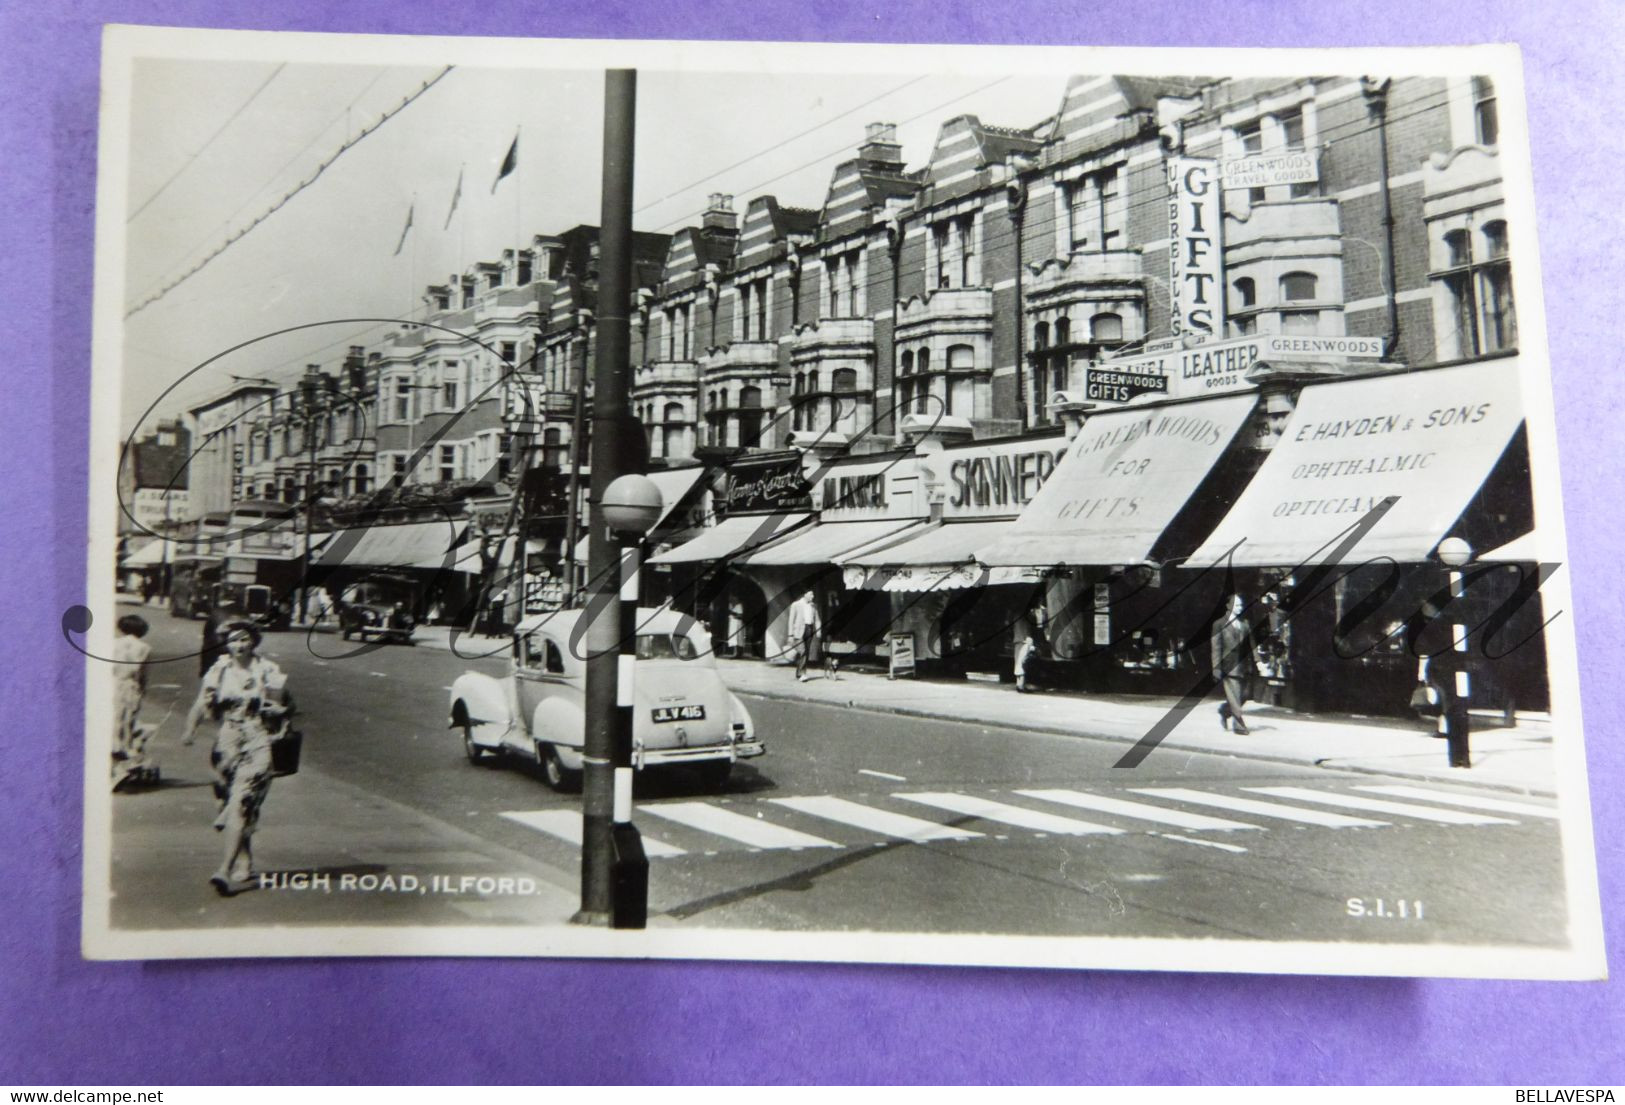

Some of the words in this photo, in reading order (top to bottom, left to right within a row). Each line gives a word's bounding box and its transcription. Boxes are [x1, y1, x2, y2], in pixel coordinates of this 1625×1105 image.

[1226, 155, 1312, 177] GREENWOODS
[1227, 174, 1268, 185] TRAVEL
[1274, 169, 1312, 181] GOODS
[1168, 165, 1182, 337] UMBRELLAS
[1184, 167, 1214, 337] GIFTS
[1271, 338, 1380, 354] GREENWOODS
[1182, 343, 1259, 379] LEATHER
[1088, 371, 1164, 389] GREENWOODS
[1088, 383, 1129, 401] GIFTS
[1205, 374, 1238, 388] GOODS
[1423, 403, 1491, 429] SONS
[1076, 414, 1226, 458] GREENWOODS
[949, 448, 1068, 508] SKINNER
[1108, 458, 1152, 478] FOR
[1291, 452, 1436, 480] OPHTHALMIC
